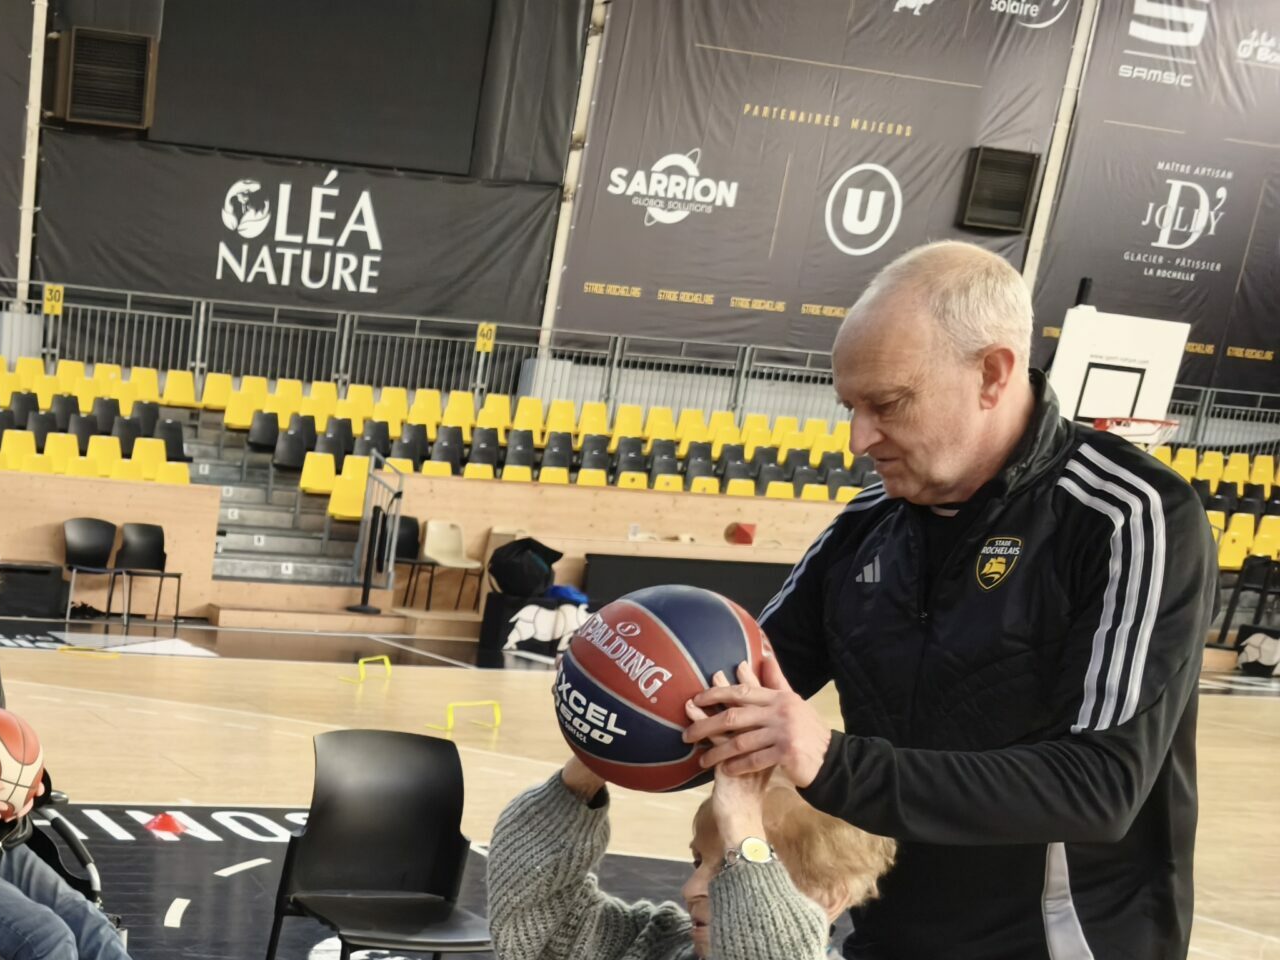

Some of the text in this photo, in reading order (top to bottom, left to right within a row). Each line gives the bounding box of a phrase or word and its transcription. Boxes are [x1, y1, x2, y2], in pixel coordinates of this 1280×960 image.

[1118, 65, 1194, 87] SAMSIC
[744, 103, 912, 137] PARTENAIRES MAJEURS
[607, 167, 738, 207] SARRION
[842, 188, 886, 235] U
[216, 241, 382, 293] NATURE
[1123, 251, 1164, 265] GLACIER
[1156, 269, 1195, 281] ROCHELLE
[46, 288, 61, 302] 30
[980, 547, 1020, 555] ROCHELAIS
[557, 663, 627, 736] XCEL
